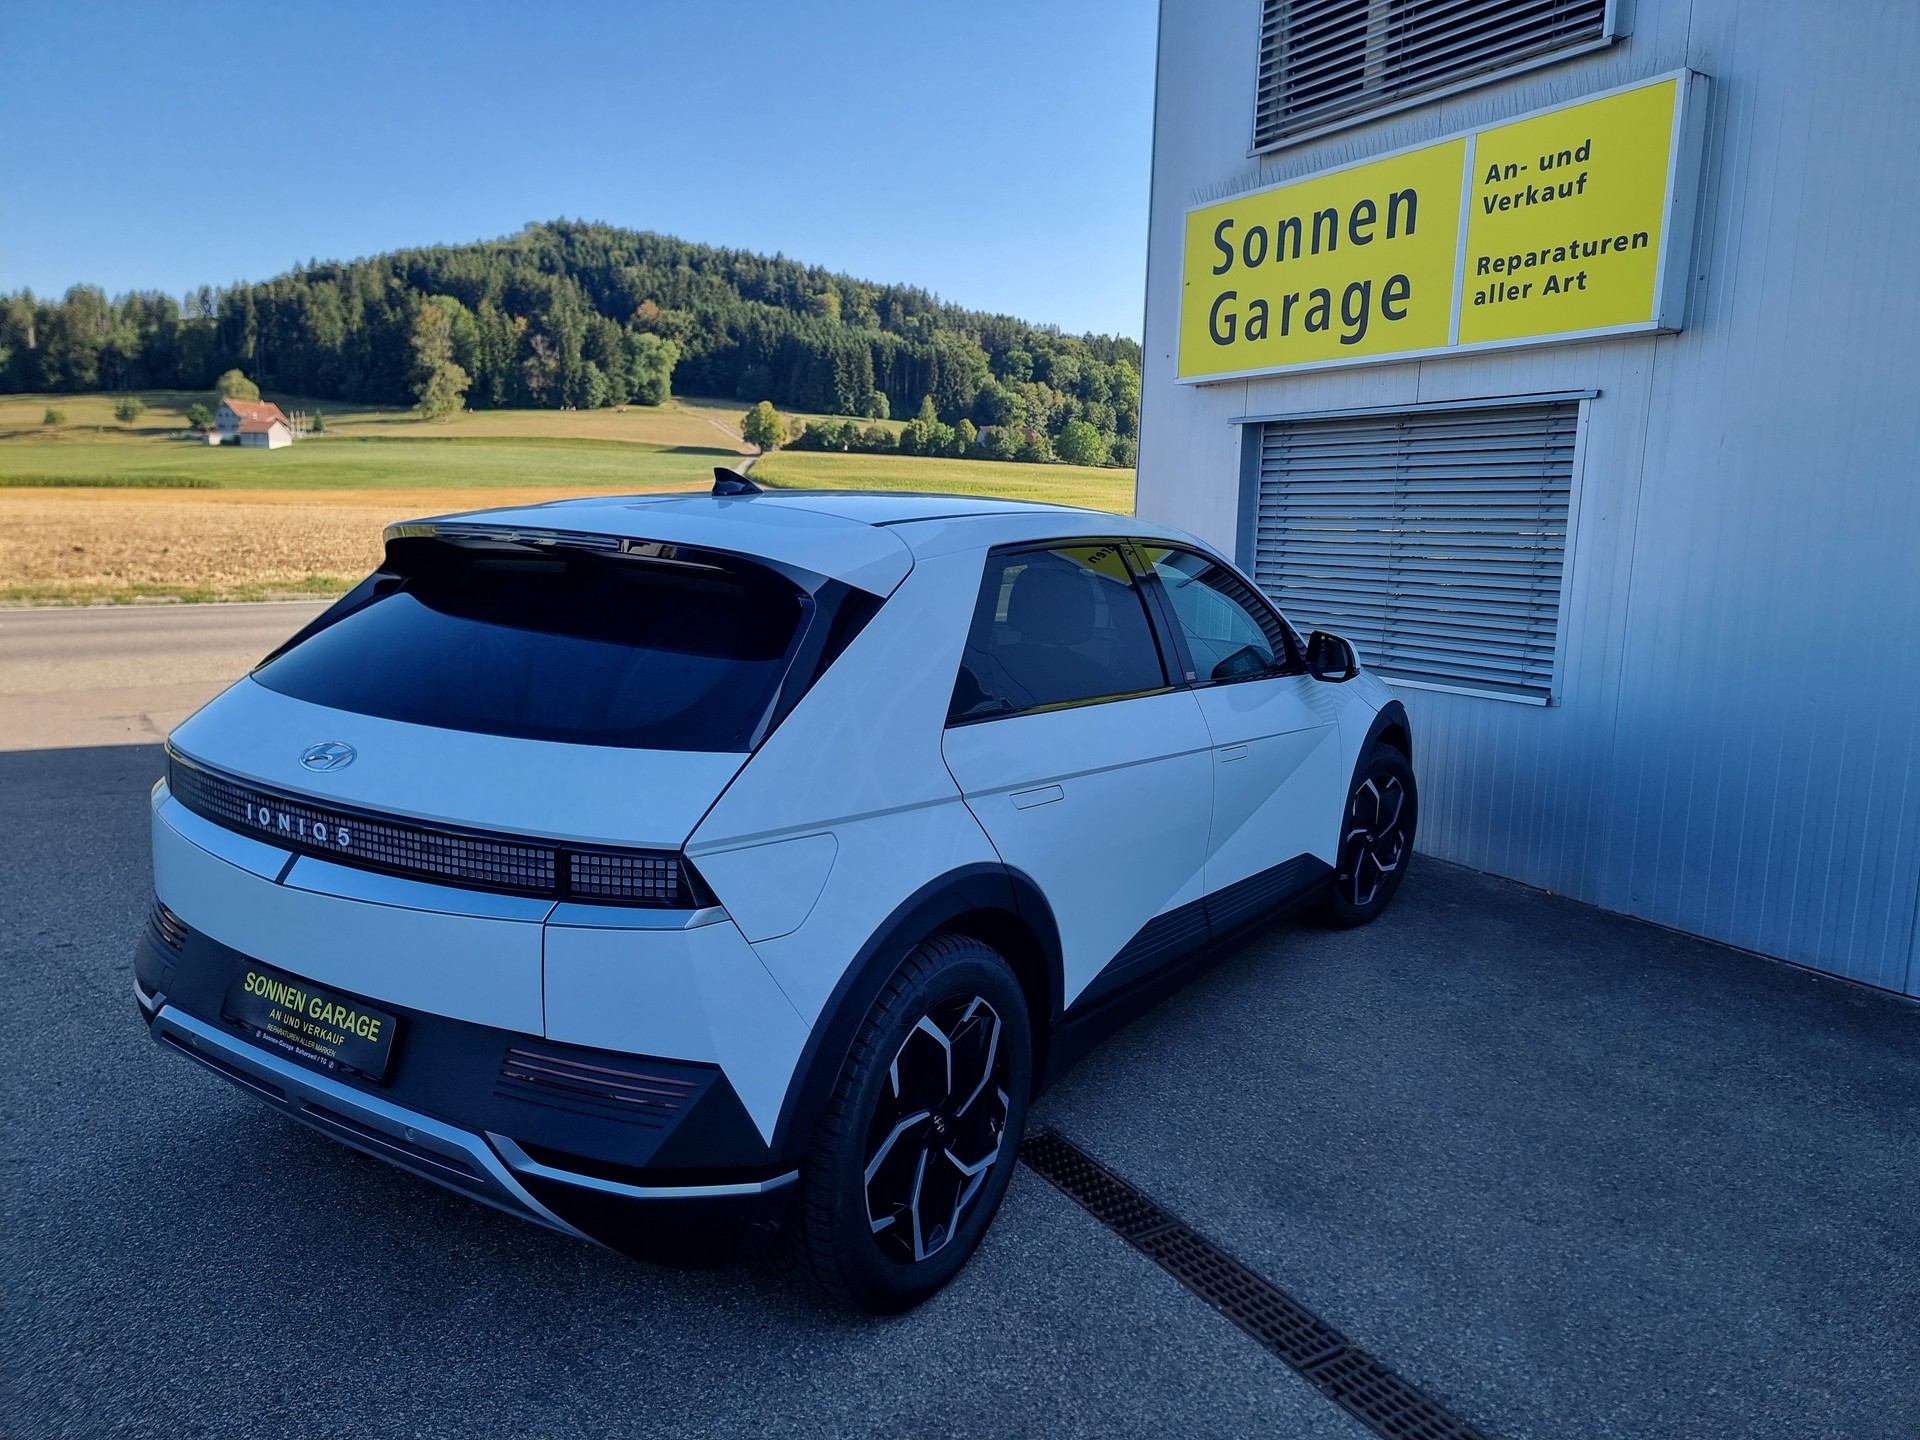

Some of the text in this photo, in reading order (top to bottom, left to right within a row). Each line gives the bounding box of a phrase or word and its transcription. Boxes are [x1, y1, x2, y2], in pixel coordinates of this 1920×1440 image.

[1484, 138, 1592, 185] An- und
[1482, 172, 1588, 215] Verkauf
[1211, 186, 1418, 276] Sonnen
[1476, 229, 1649, 277] Reparaturen
[1208, 271, 1412, 346] Garage
[1473, 270, 1588, 307] aller Art
[247, 803, 350, 846] IONIQ 5
[244, 971, 382, 1042] SONNEN GARAGE
[268, 1008, 346, 1046] AN UND VERKAUF
[266, 1023, 337, 1058] REPARATUREN ALLER MARKEN
